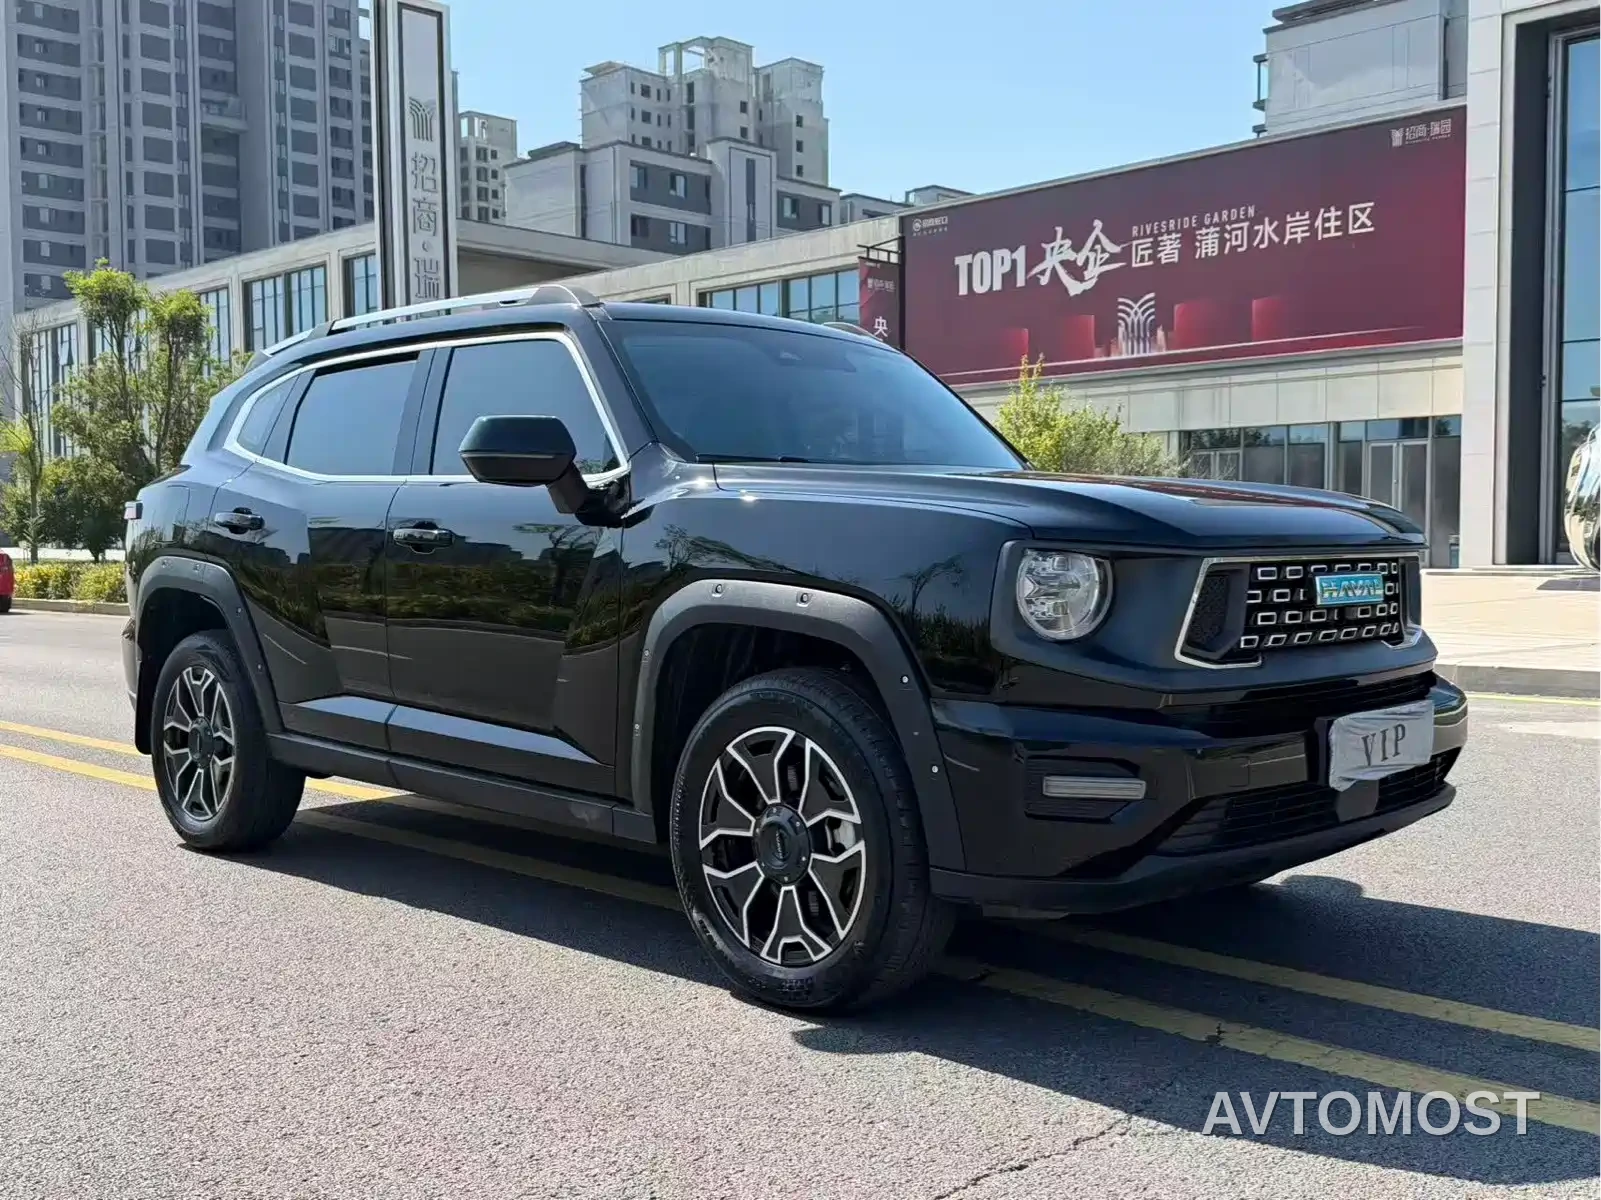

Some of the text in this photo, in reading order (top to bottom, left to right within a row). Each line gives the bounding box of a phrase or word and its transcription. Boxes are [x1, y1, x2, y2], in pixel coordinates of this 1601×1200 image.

[1132, 204, 1256, 238] RIVESRIDE GARDEN
[954, 245, 1026, 296] TOP1
[1195, 201, 1375, 260] 蒲河水岸住区
[874, 316, 888, 338] 央
[1321, 579, 1384, 600] HAVAL
[1361, 722, 1406, 767] VIP
